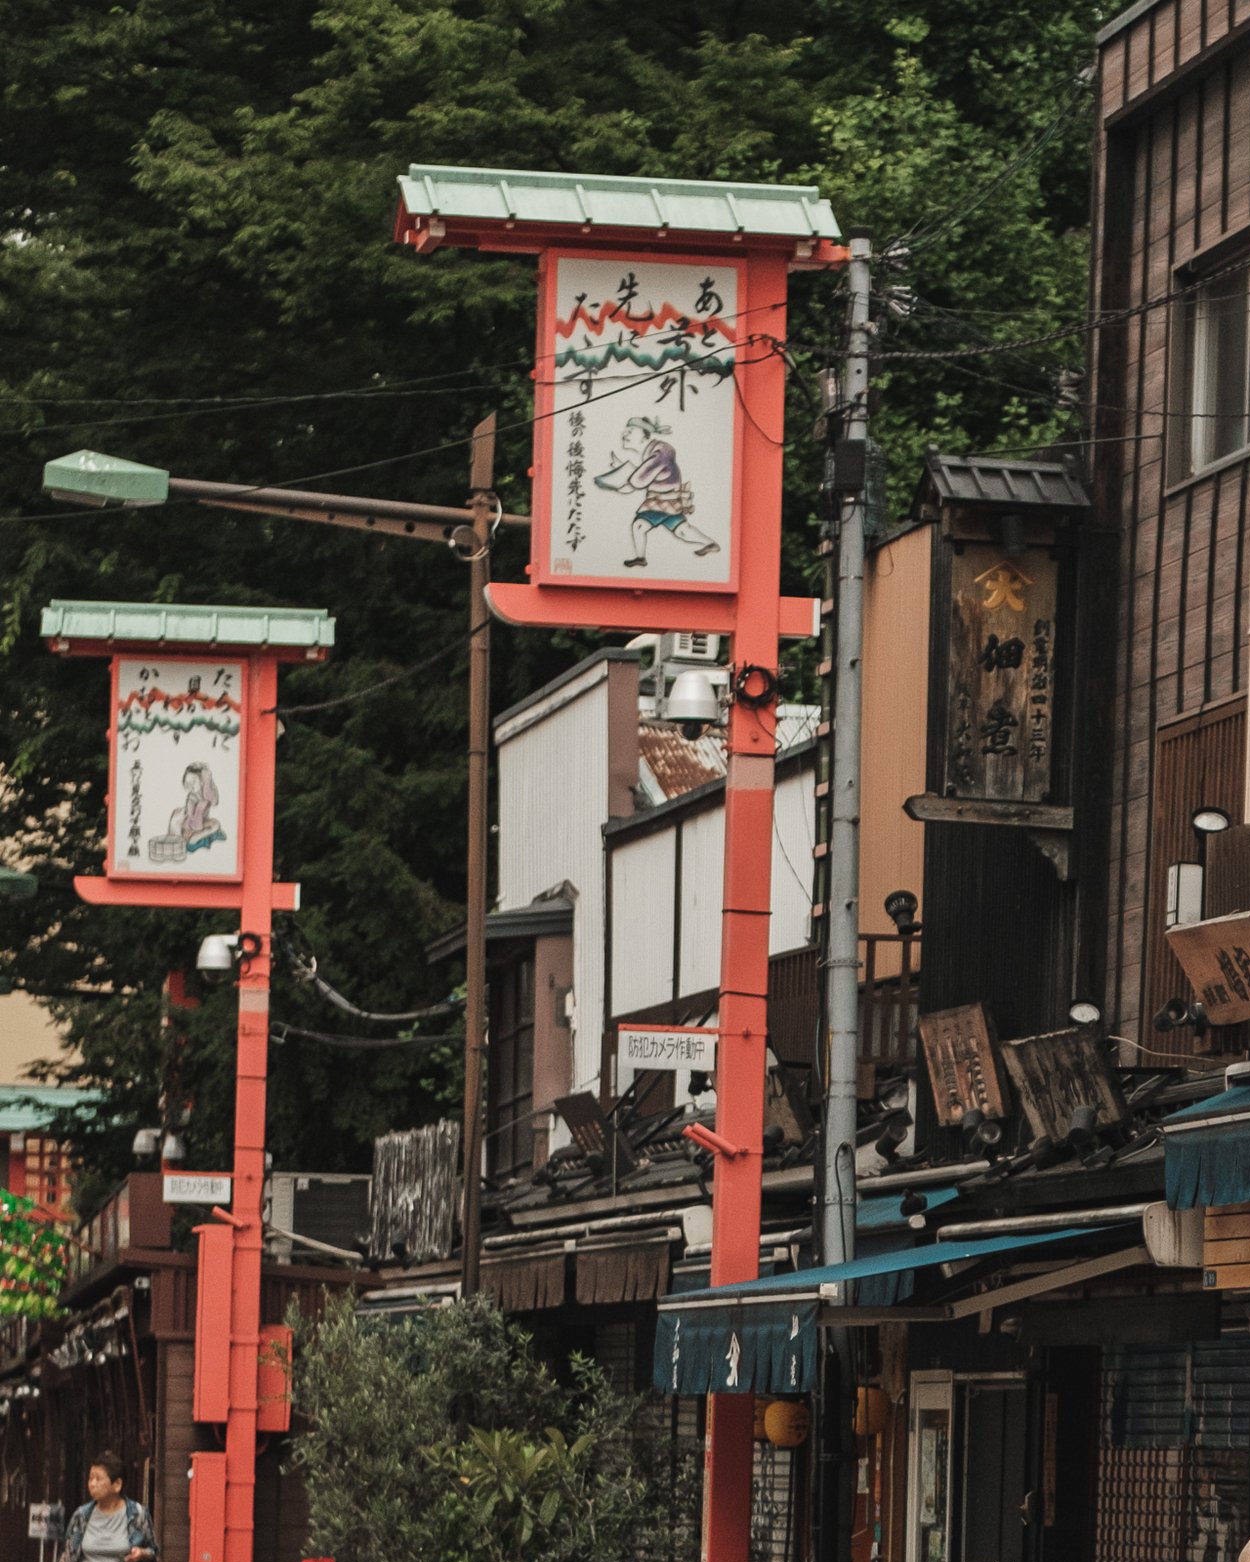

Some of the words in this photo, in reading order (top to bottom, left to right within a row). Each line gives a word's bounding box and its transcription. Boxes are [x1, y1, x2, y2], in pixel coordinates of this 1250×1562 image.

[566, 409, 588, 553] 後の後悔先にたたず
[628, 1034, 705, 1062] 防犯カメラ作動中
